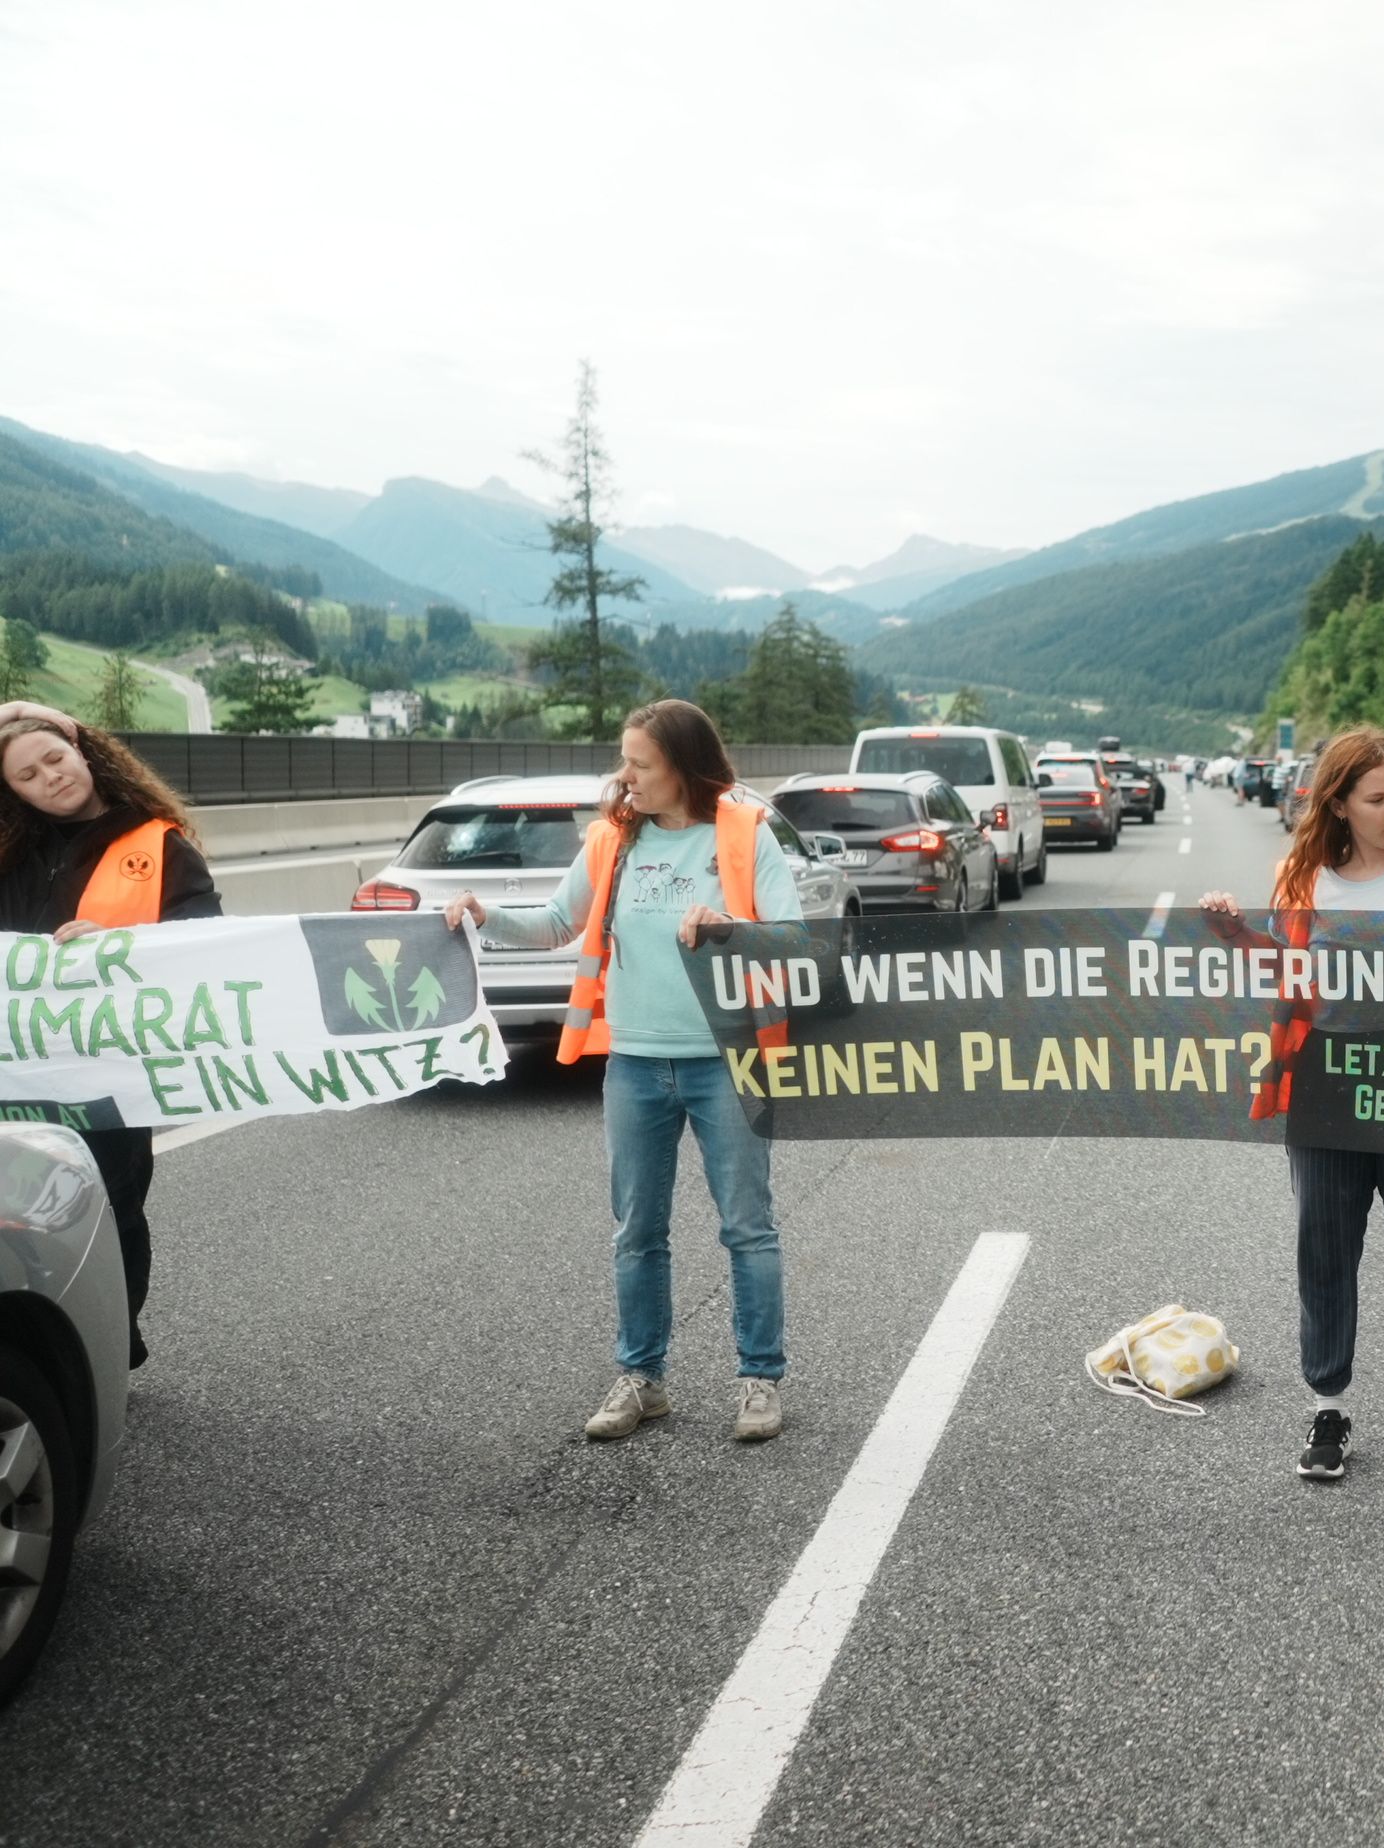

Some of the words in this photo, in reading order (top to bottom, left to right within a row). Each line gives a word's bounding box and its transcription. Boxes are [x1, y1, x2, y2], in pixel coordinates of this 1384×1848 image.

[6, 930, 143, 992] DER
[711, 954, 821, 1010] UND
[841, 949, 1003, 1004] WENN
[1023, 947, 1107, 997] DIE
[0, 980, 263, 1062] IMARAT
[142, 1053, 275, 1116] EIN
[726, 1040, 939, 1098] KEINEN
[960, 1031, 1111, 1092] PLAN
[1133, 1032, 1271, 1094] HAT?
[57, 1104, 92, 1130] AT
